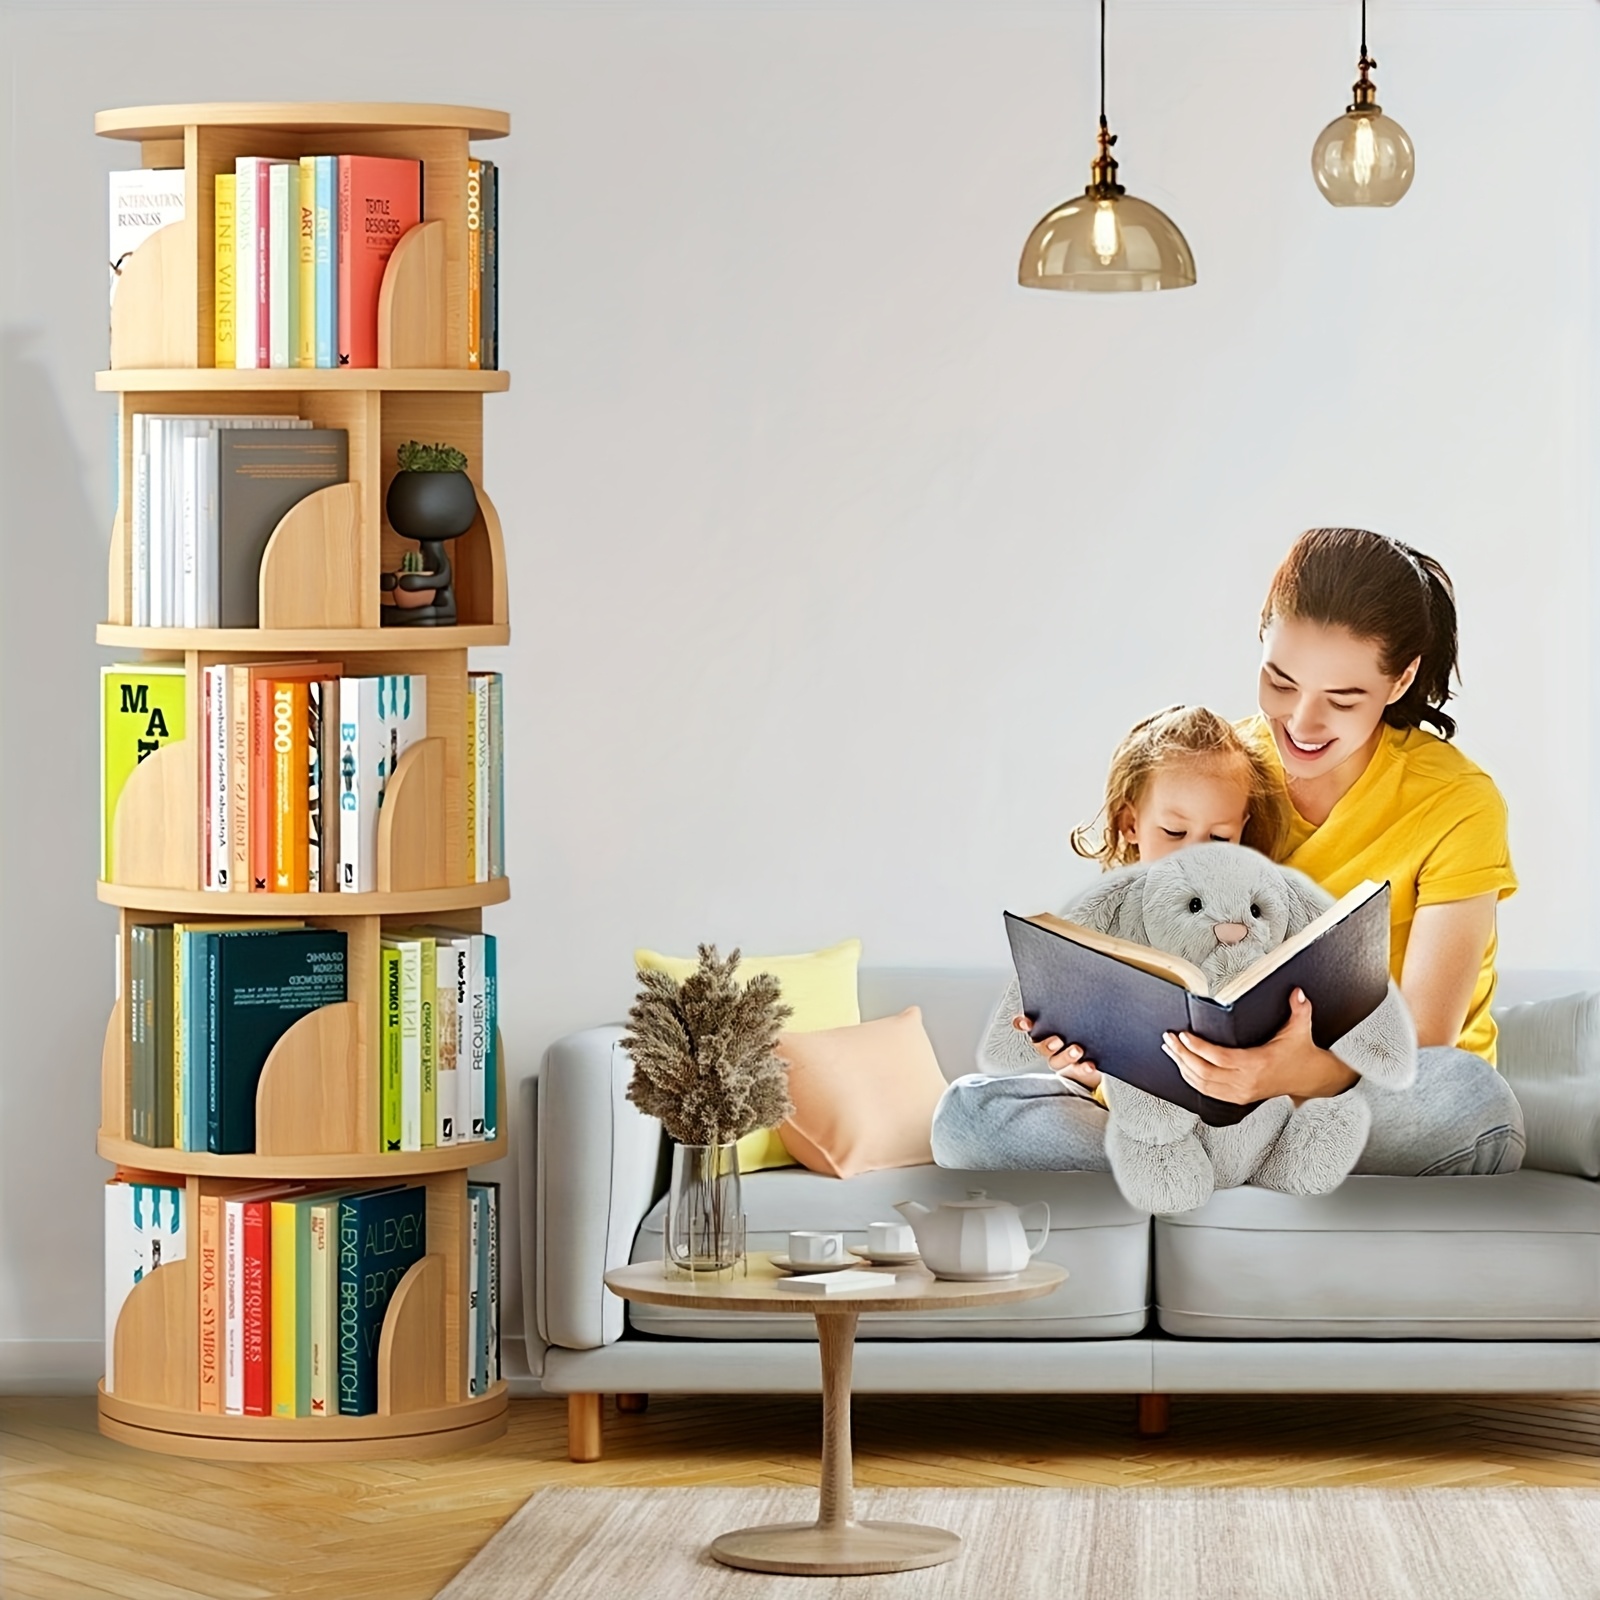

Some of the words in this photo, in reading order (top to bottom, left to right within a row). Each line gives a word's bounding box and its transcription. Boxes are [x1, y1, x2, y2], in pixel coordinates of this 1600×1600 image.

[218, 201, 232, 253] FINE
[239, 165, 252, 251] WINDOWS
[302, 207, 313, 240] ART
[317, 206, 329, 239] ART
[218, 265, 232, 342] WINES
[479, 685, 487, 768] WINDOWS
[472, 994, 483, 1070] REQUIEM
[203, 1248, 215, 1291] BOOK
[341, 1203, 358, 1277] ALEXEY
[364, 1213, 423, 1258] ALEXEY
[203, 1307, 215, 1384] SYMBOLS
[248, 1257, 262, 1363] ANTIQUAIRES
[341, 1282, 358, 1402] BRODOVITCH
